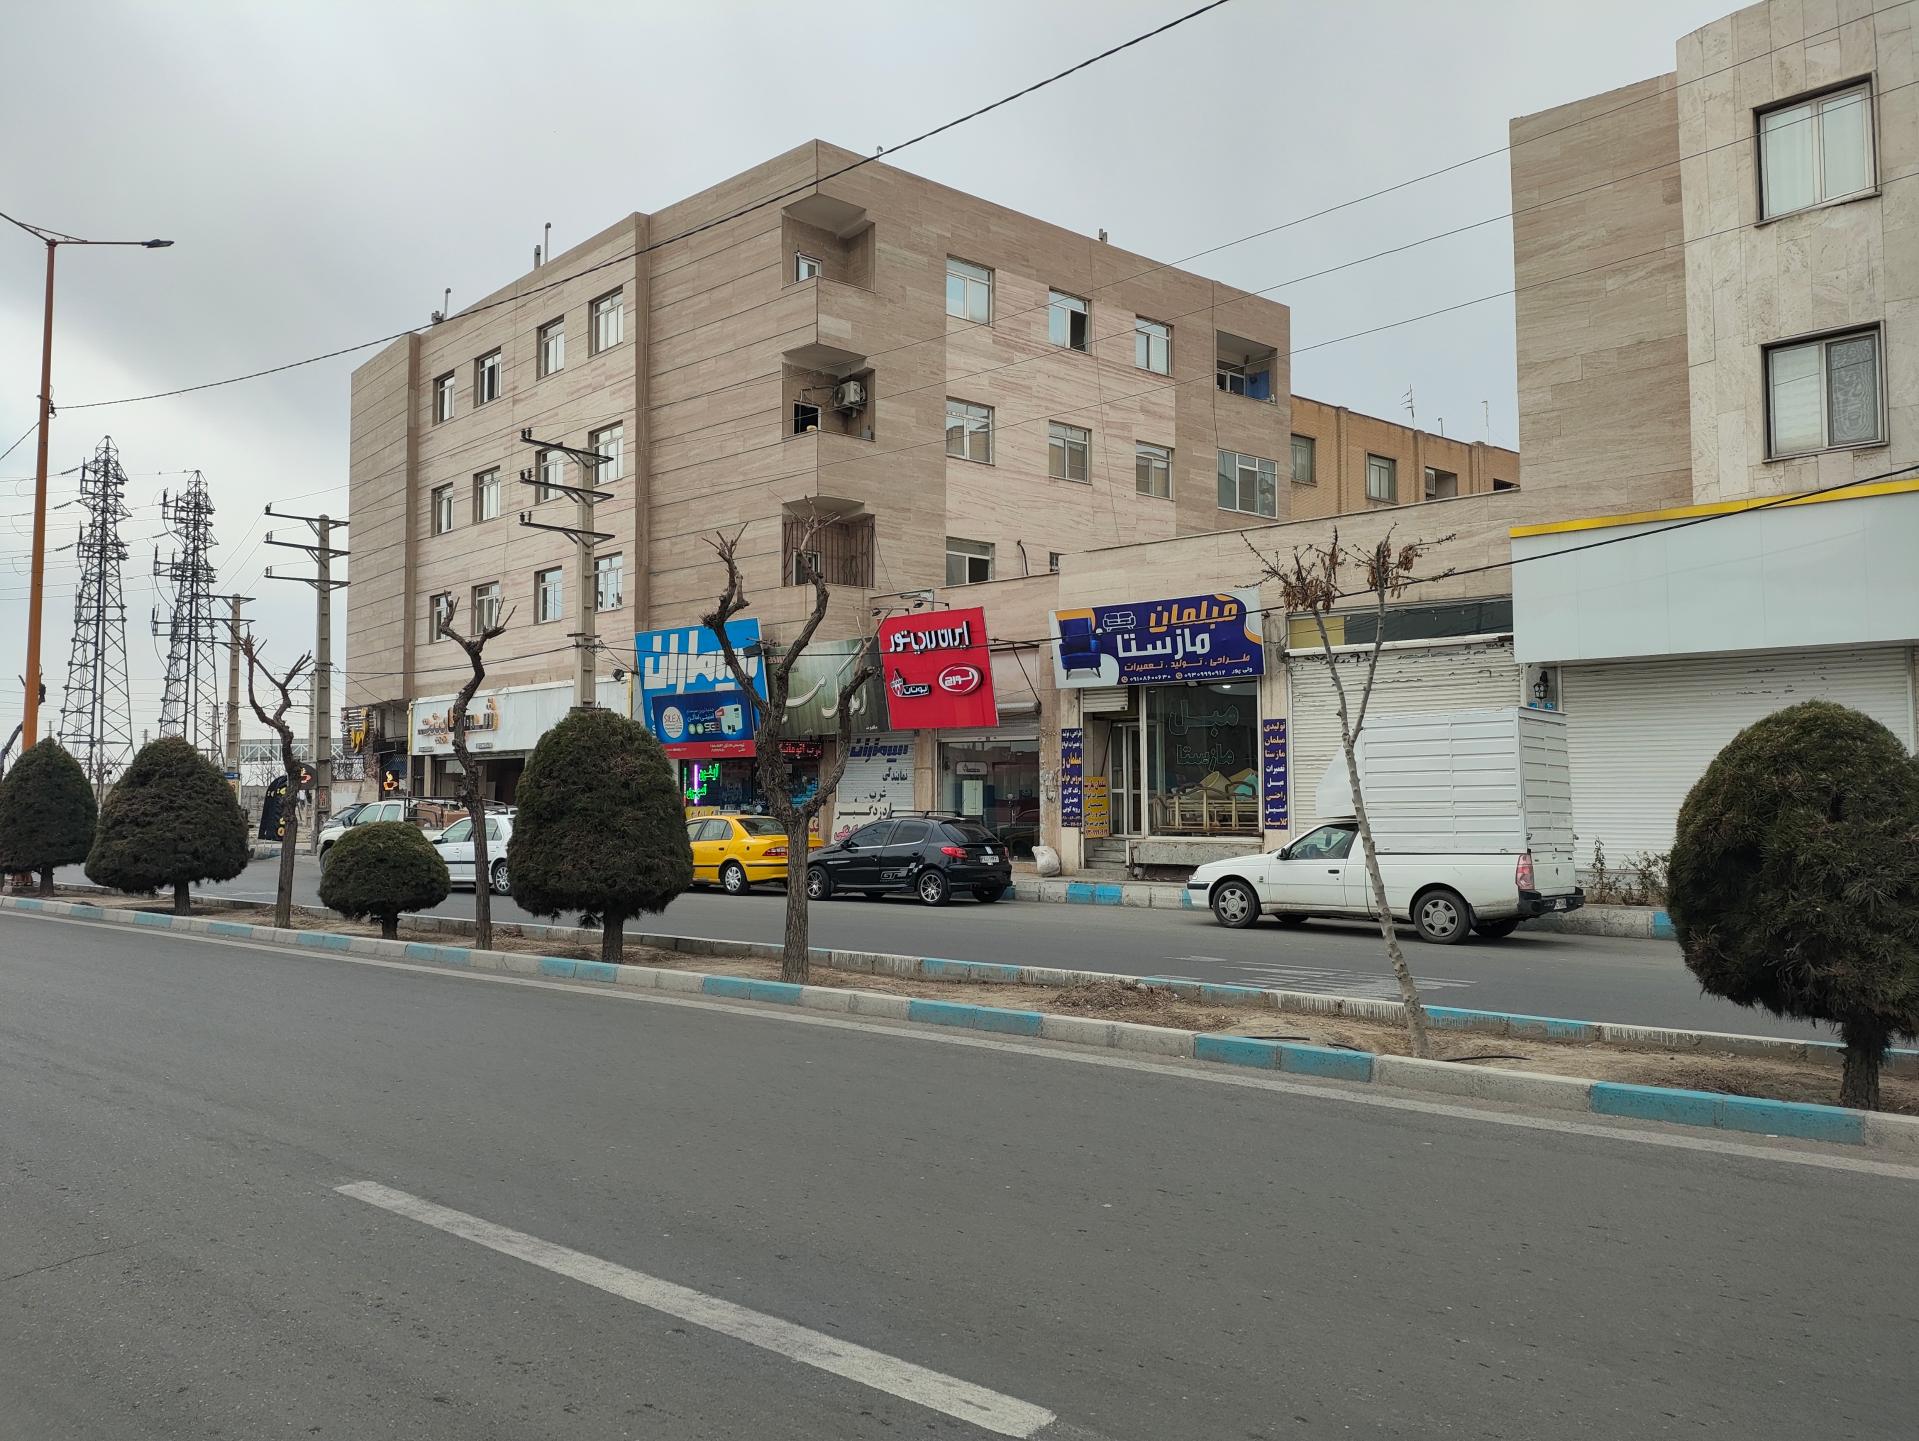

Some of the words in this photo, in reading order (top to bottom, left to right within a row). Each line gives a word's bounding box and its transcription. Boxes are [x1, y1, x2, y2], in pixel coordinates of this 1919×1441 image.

[1149, 600, 1238, 633] مبلمان
[937, 620, 970, 648] ایران
[889, 629, 935, 655] رادیاتور
[1116, 627, 1211, 660] مازستا
[1124, 660, 1164, 672] تعمیرات
[1171, 657, 1203, 669] تولید
[1210, 653, 1250, 667] طراحی
[903, 684, 930, 695] بوتان
[1169, 699, 1239, 738] مبل
[1263, 722, 1286, 732] تولیدی
[1264, 736, 1286, 746] مبلمان
[1176, 743, 1235, 773] مازستا
[1264, 749, 1286, 760] مازستا
[1265, 764, 1286, 775] تعمیرات
[1267, 778, 1285, 788] مبل
[1265, 791, 1286, 801] راحتی
[1265, 817, 1288, 828] کلاسیک
